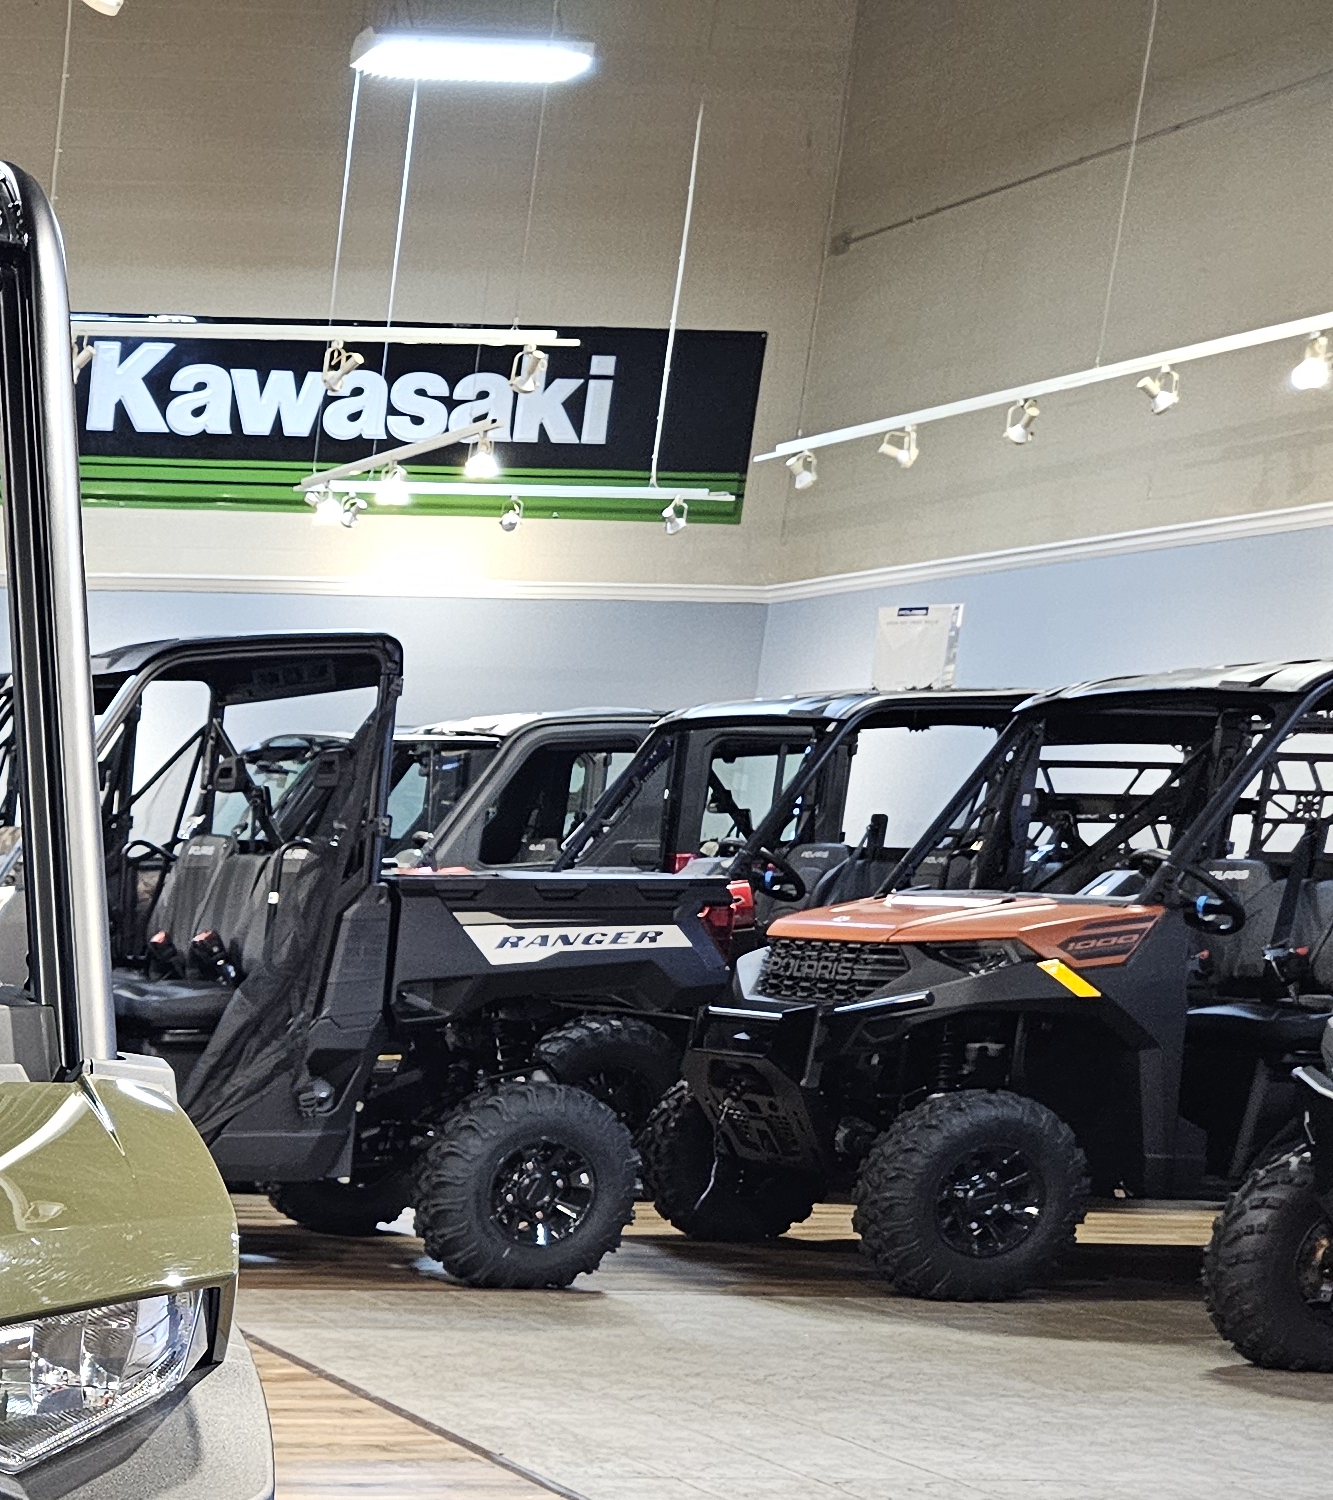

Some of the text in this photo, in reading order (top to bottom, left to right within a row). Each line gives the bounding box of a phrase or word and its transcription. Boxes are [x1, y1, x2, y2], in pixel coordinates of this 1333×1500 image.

[86, 341, 616, 444] Kawasaki
[494, 930, 664, 949] RANGER
[1067, 933, 1140, 951] 1000
[769, 957, 853, 980] POLARIS
